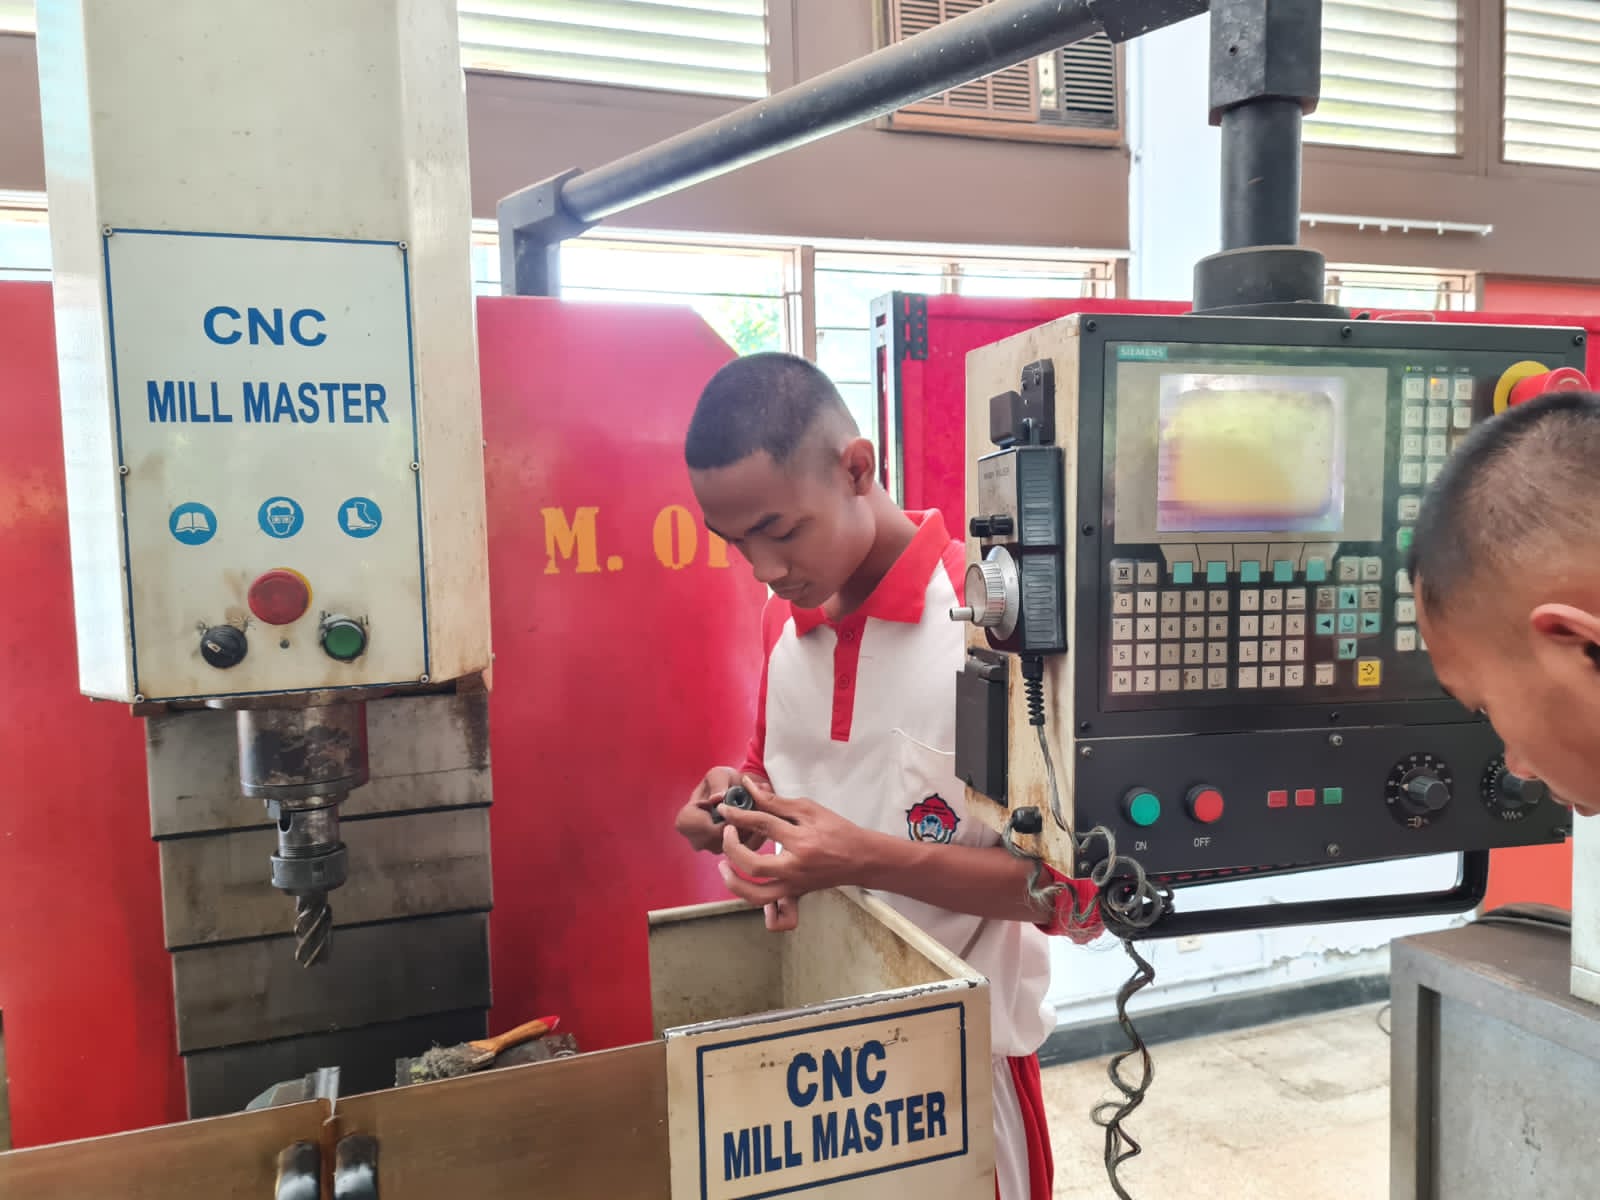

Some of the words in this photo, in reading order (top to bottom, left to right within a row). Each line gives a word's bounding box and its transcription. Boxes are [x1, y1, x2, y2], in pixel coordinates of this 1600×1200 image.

[203, 305, 328, 347] CNC
[1120, 348, 1163, 357] SIEMENS
[146, 380, 233, 423] MILL
[243, 382, 389, 423] MASTER
[540, 506, 624, 575] M.
[1135, 841, 1147, 851] ON
[1193, 837, 1211, 848] OFF
[787, 1039, 887, 1108] CNC
[723, 1119, 803, 1182] MILL
[812, 1090, 947, 1162] MASTER
